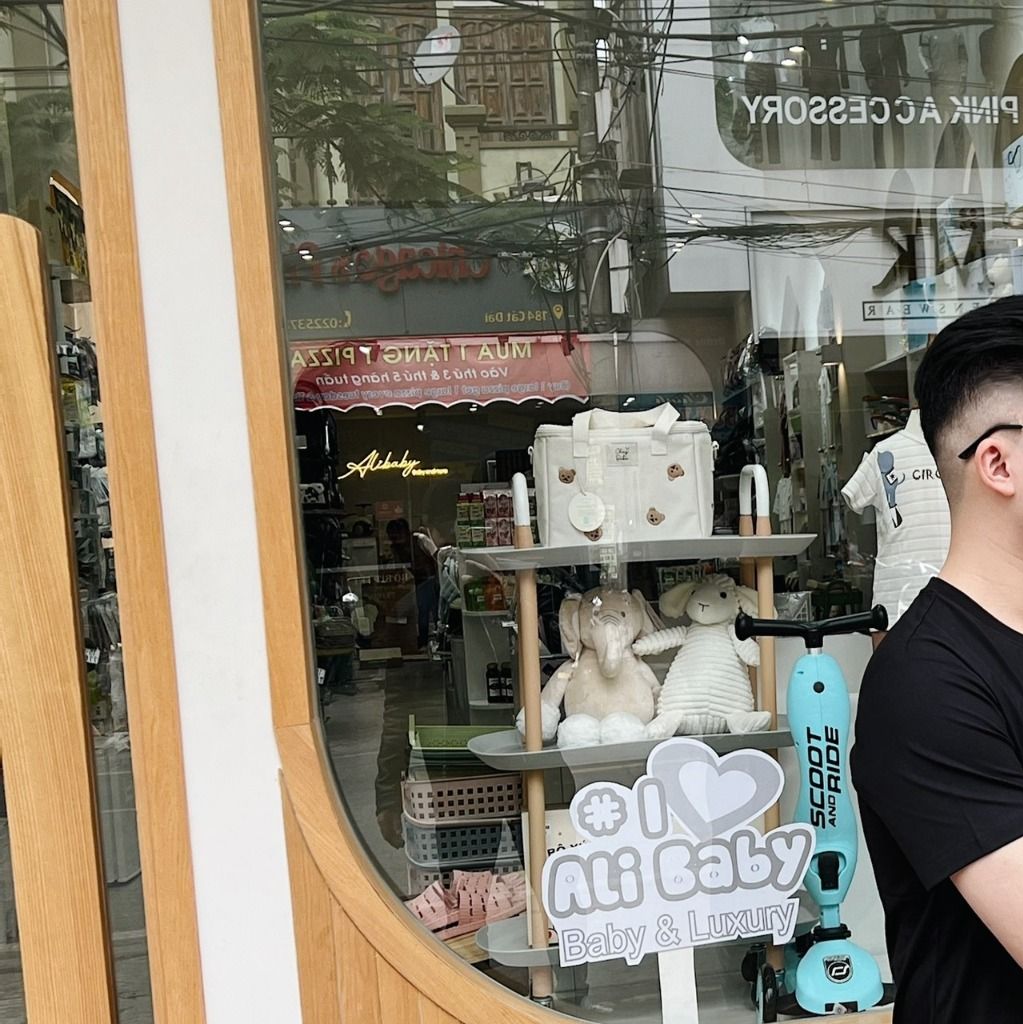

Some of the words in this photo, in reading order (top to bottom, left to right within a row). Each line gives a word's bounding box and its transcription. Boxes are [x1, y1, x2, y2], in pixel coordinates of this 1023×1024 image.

[806, 726, 826, 829] SCOOT
[824, 725, 842, 794] RIDE
[828, 794, 837, 828] AND
[653, 829, 812, 901] Baby
[561, 923, 646, 962] Baby
[655, 914, 682, 947] &
[688, 902, 795, 943] Luxury
